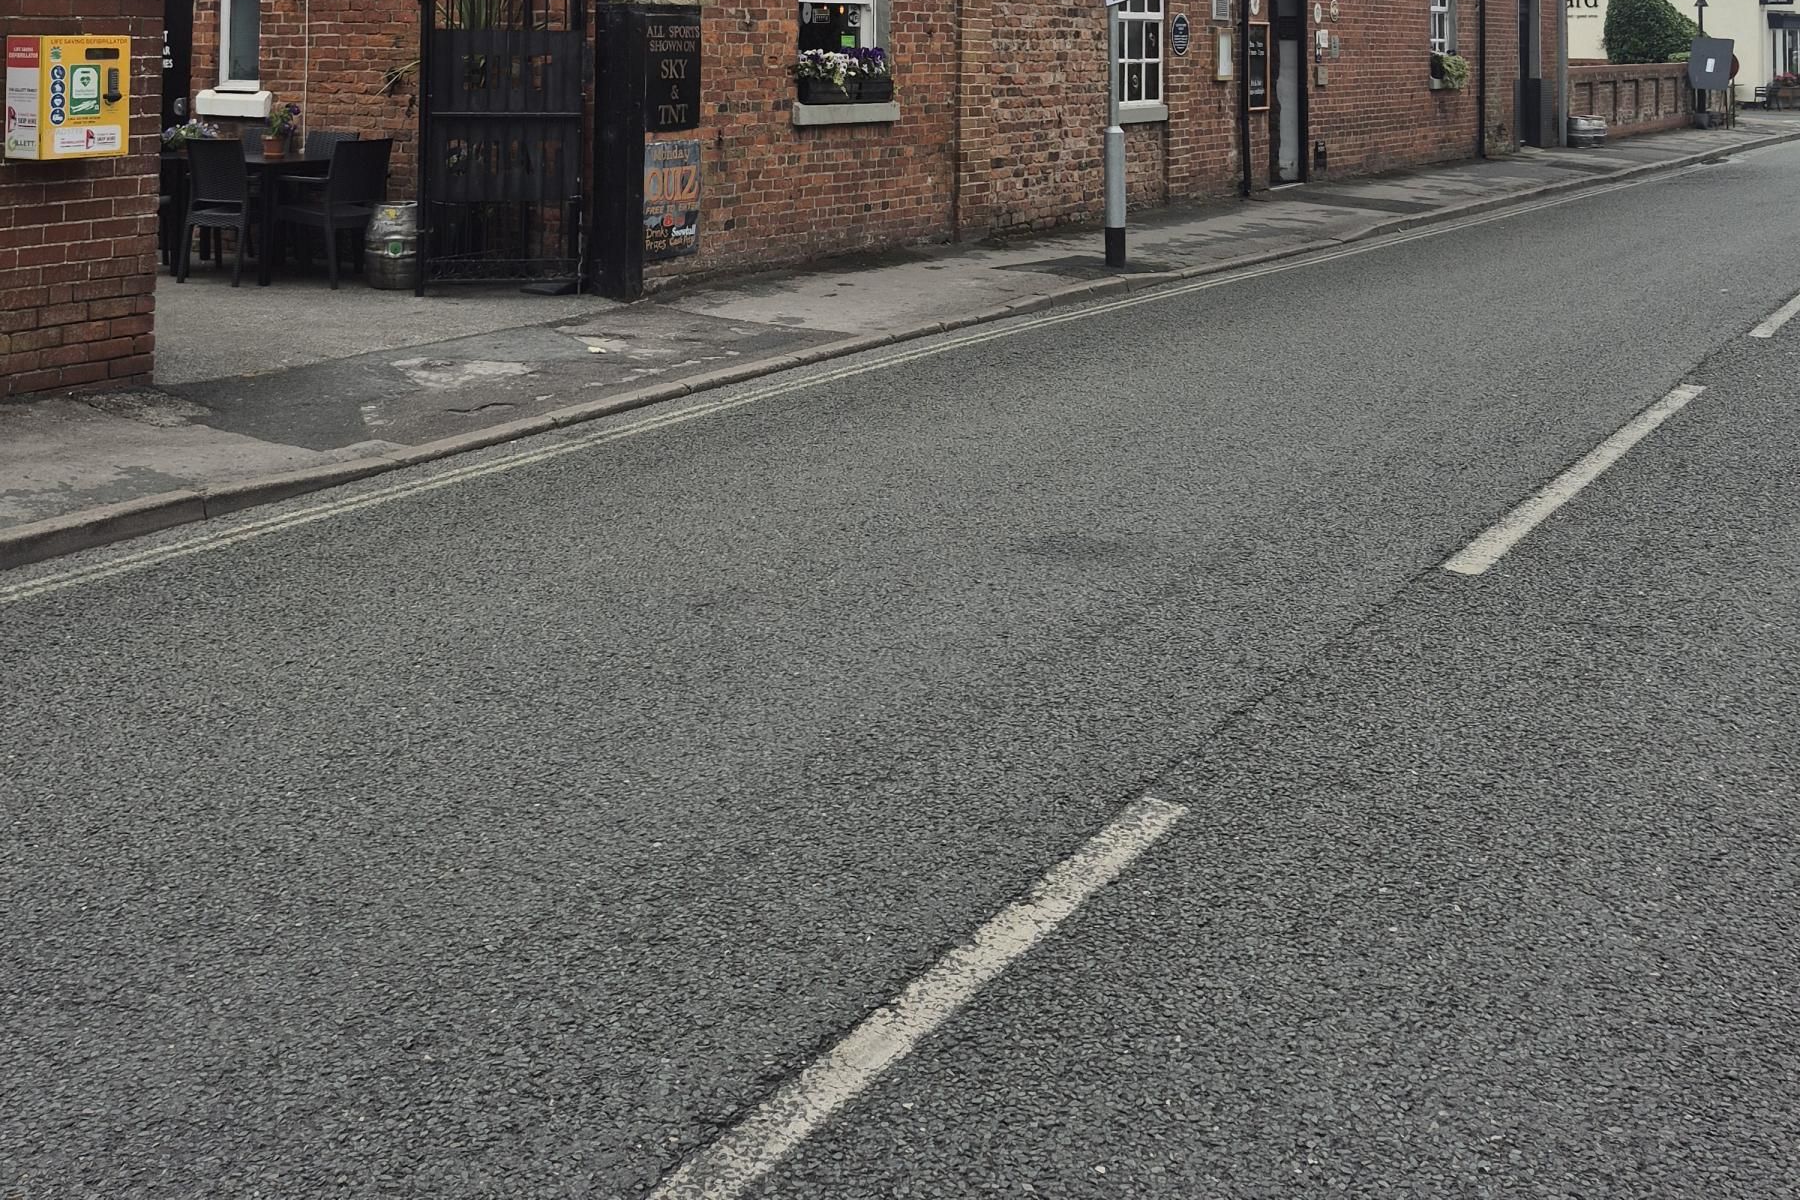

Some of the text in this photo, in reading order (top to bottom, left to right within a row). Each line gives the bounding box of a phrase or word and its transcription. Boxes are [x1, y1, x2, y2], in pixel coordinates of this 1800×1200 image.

[646, 25, 700, 39] ALL SPORTS
[649, 40, 696, 52] SHOWN ON
[660, 58, 688, 79] SKY
[670, 84, 679, 100] &
[658, 103, 689, 125] TNT
[645, 164, 699, 202] QUIZ
